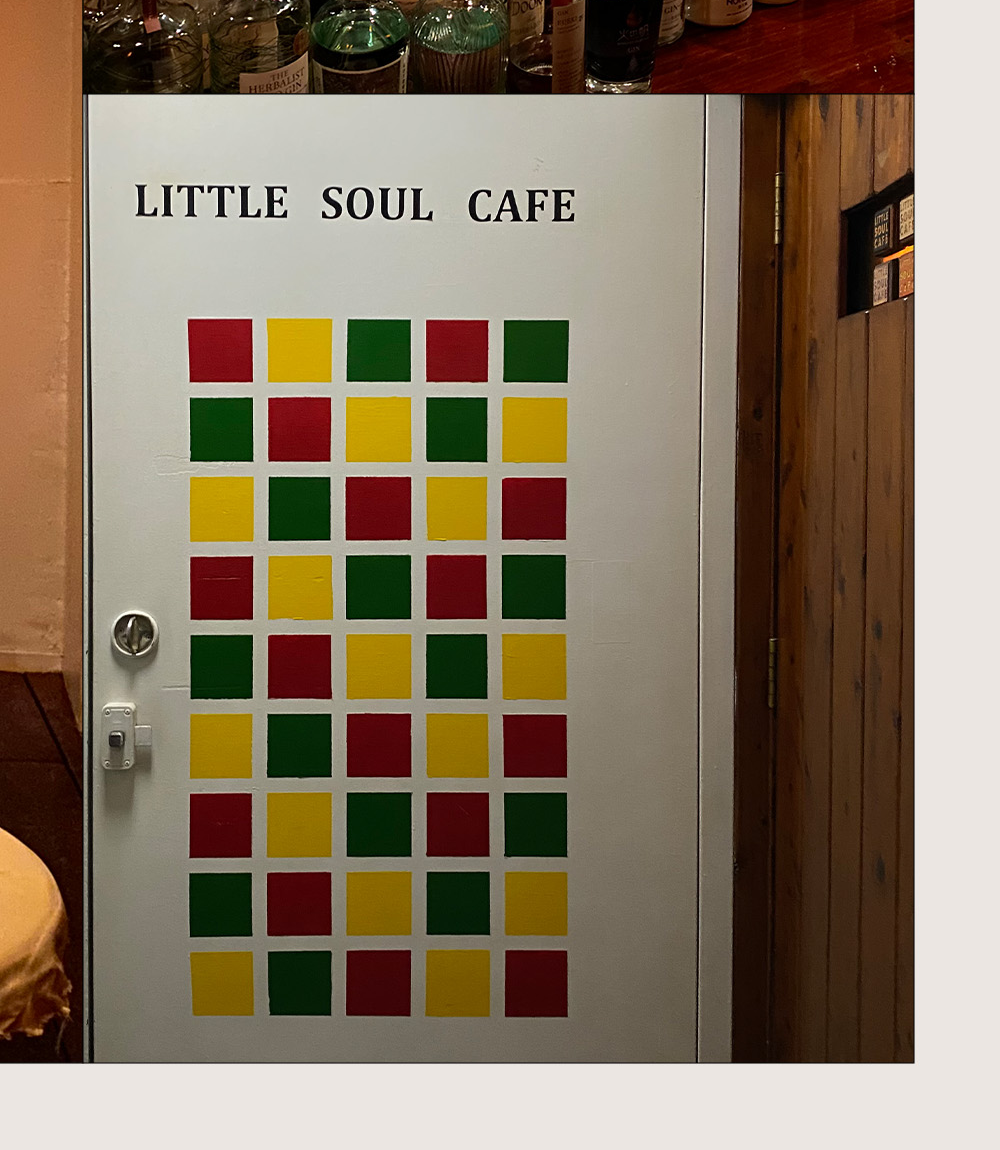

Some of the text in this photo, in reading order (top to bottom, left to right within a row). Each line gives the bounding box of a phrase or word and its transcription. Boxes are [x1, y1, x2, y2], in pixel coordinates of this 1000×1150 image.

[248, 67, 305, 93] HERBALIST
[270, 70, 288, 82] THE
[136, 185, 574, 222] LITTLE SOUL CAFE
[874, 211, 889, 226] LITTLE
[874, 222, 889, 238] SOUL
[874, 235, 889, 249] CAFE
